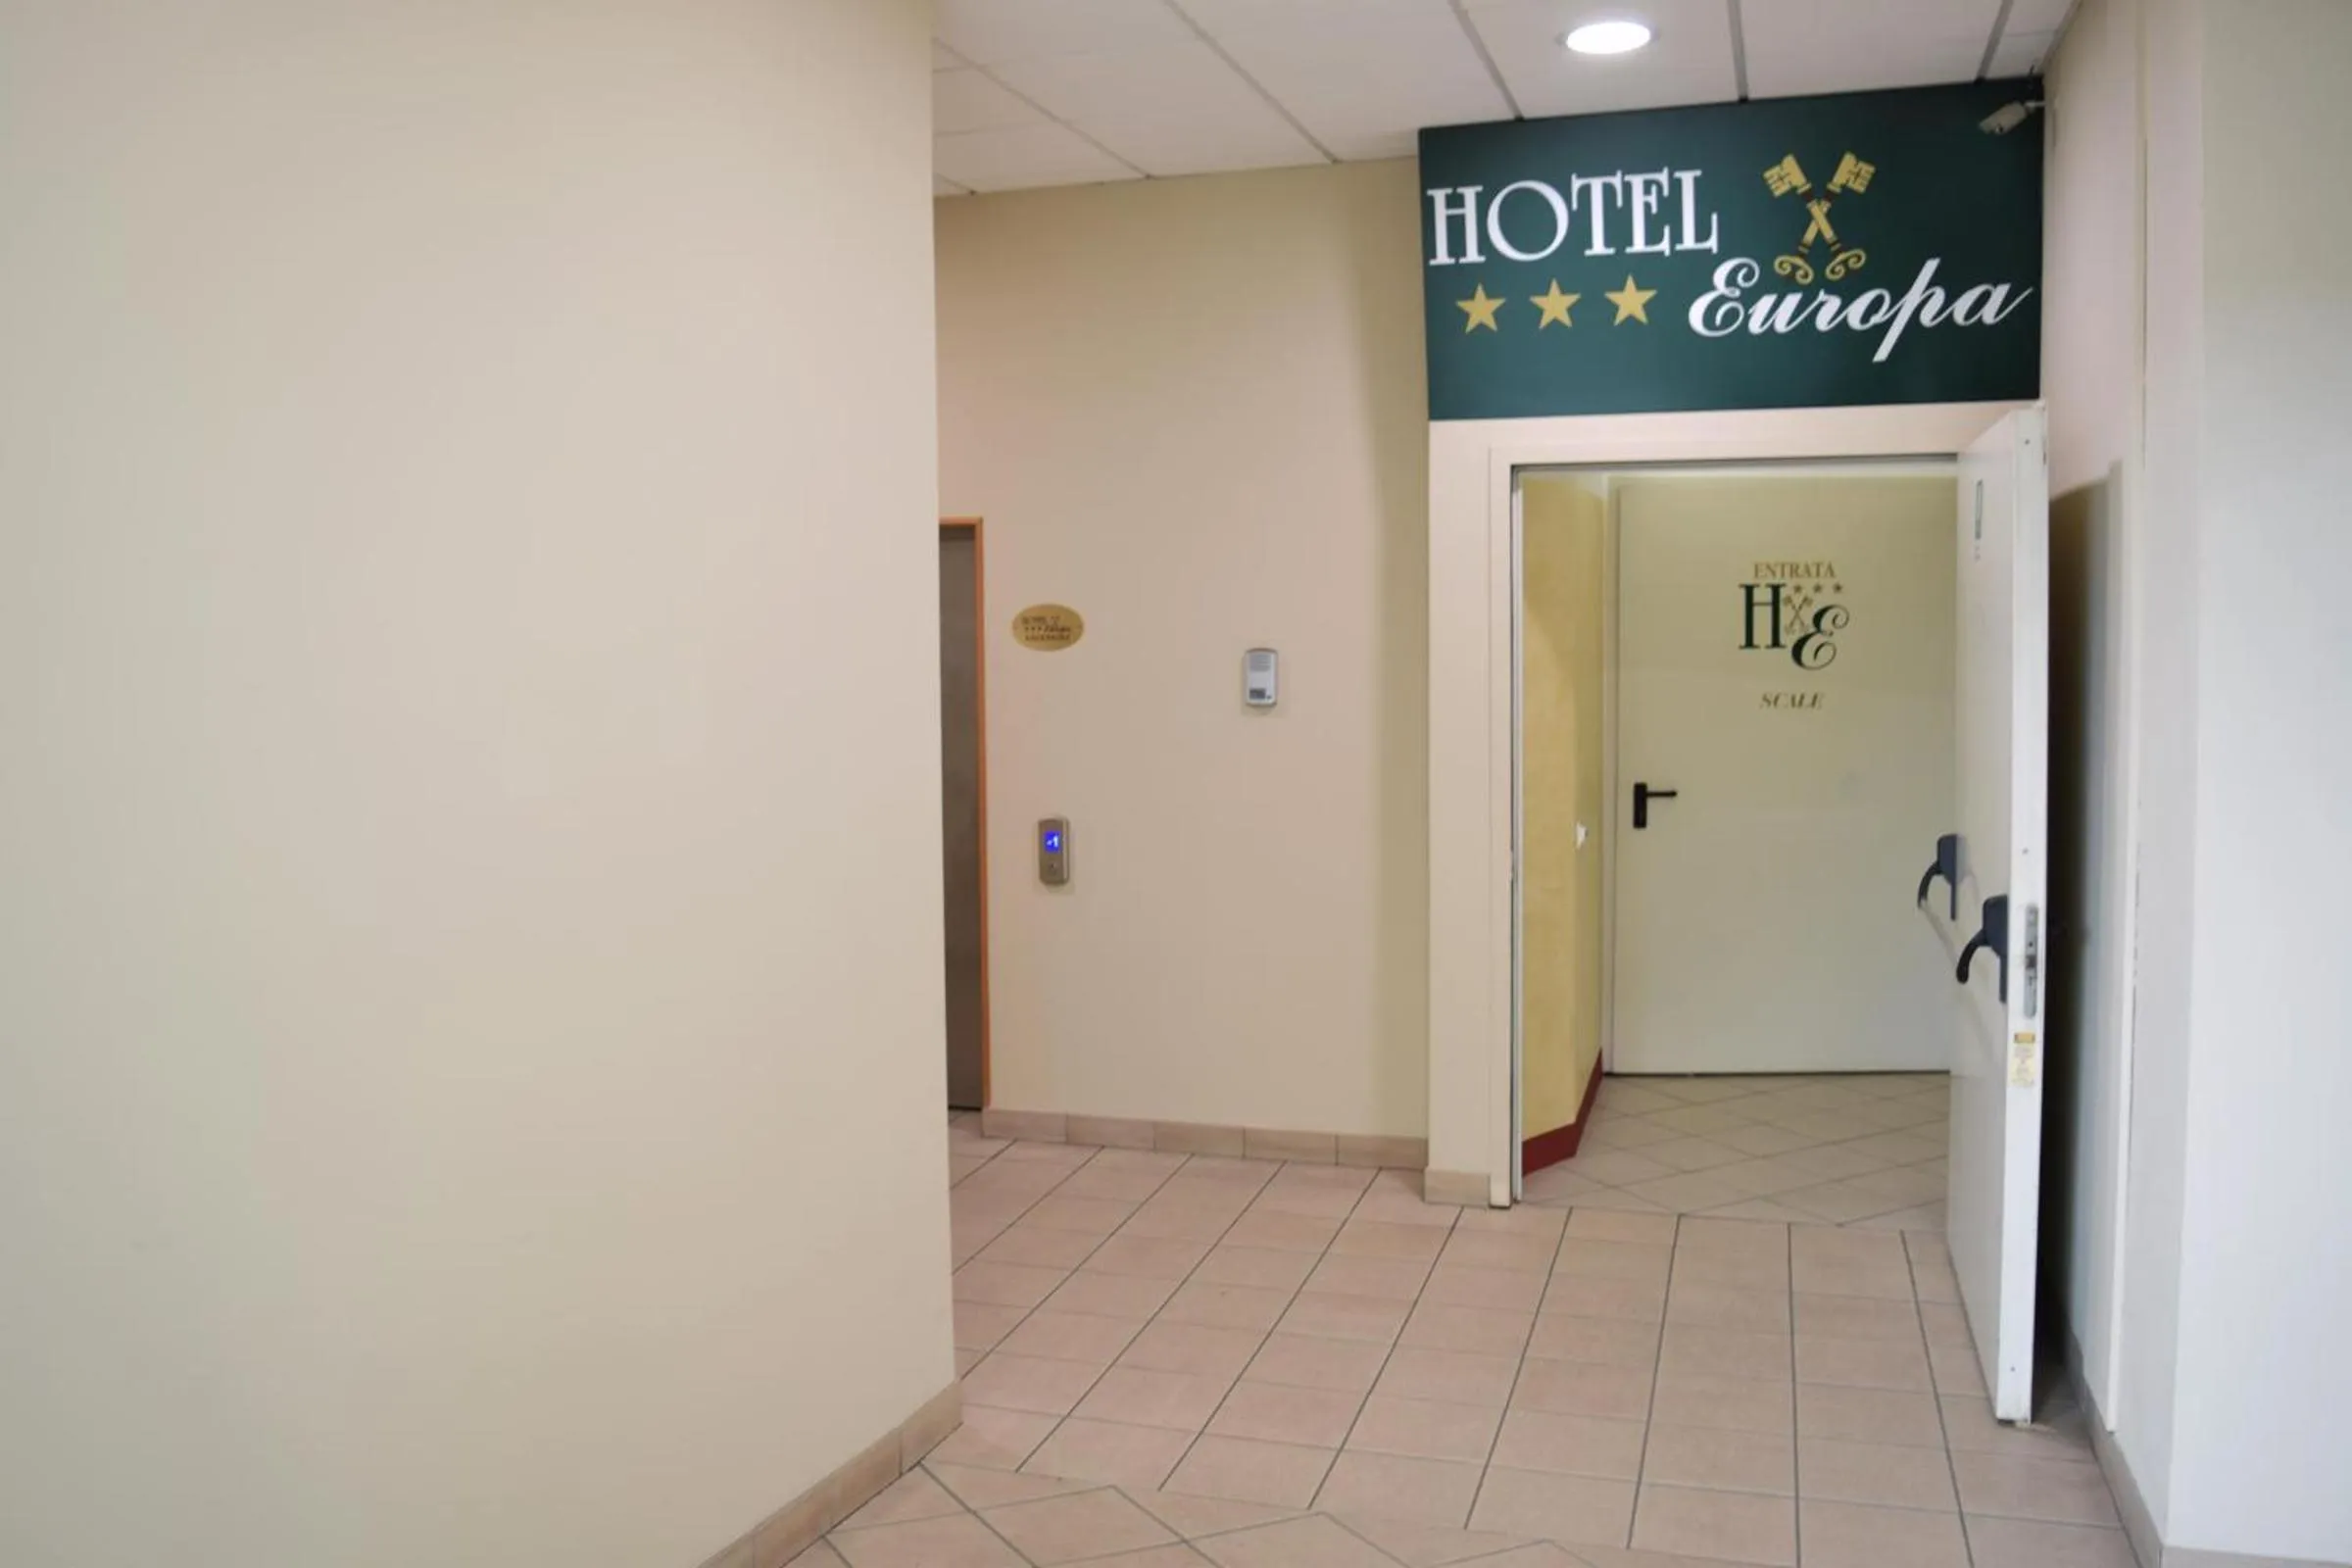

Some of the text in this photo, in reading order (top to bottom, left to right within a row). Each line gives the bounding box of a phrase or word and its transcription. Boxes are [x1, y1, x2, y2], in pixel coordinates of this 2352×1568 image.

[1426, 167, 1719, 266] HOTEL
[1688, 257, 2034, 364] Europa
[1753, 562, 1837, 578] ENTRATA
[1760, 692, 1826, 710] SCALE
